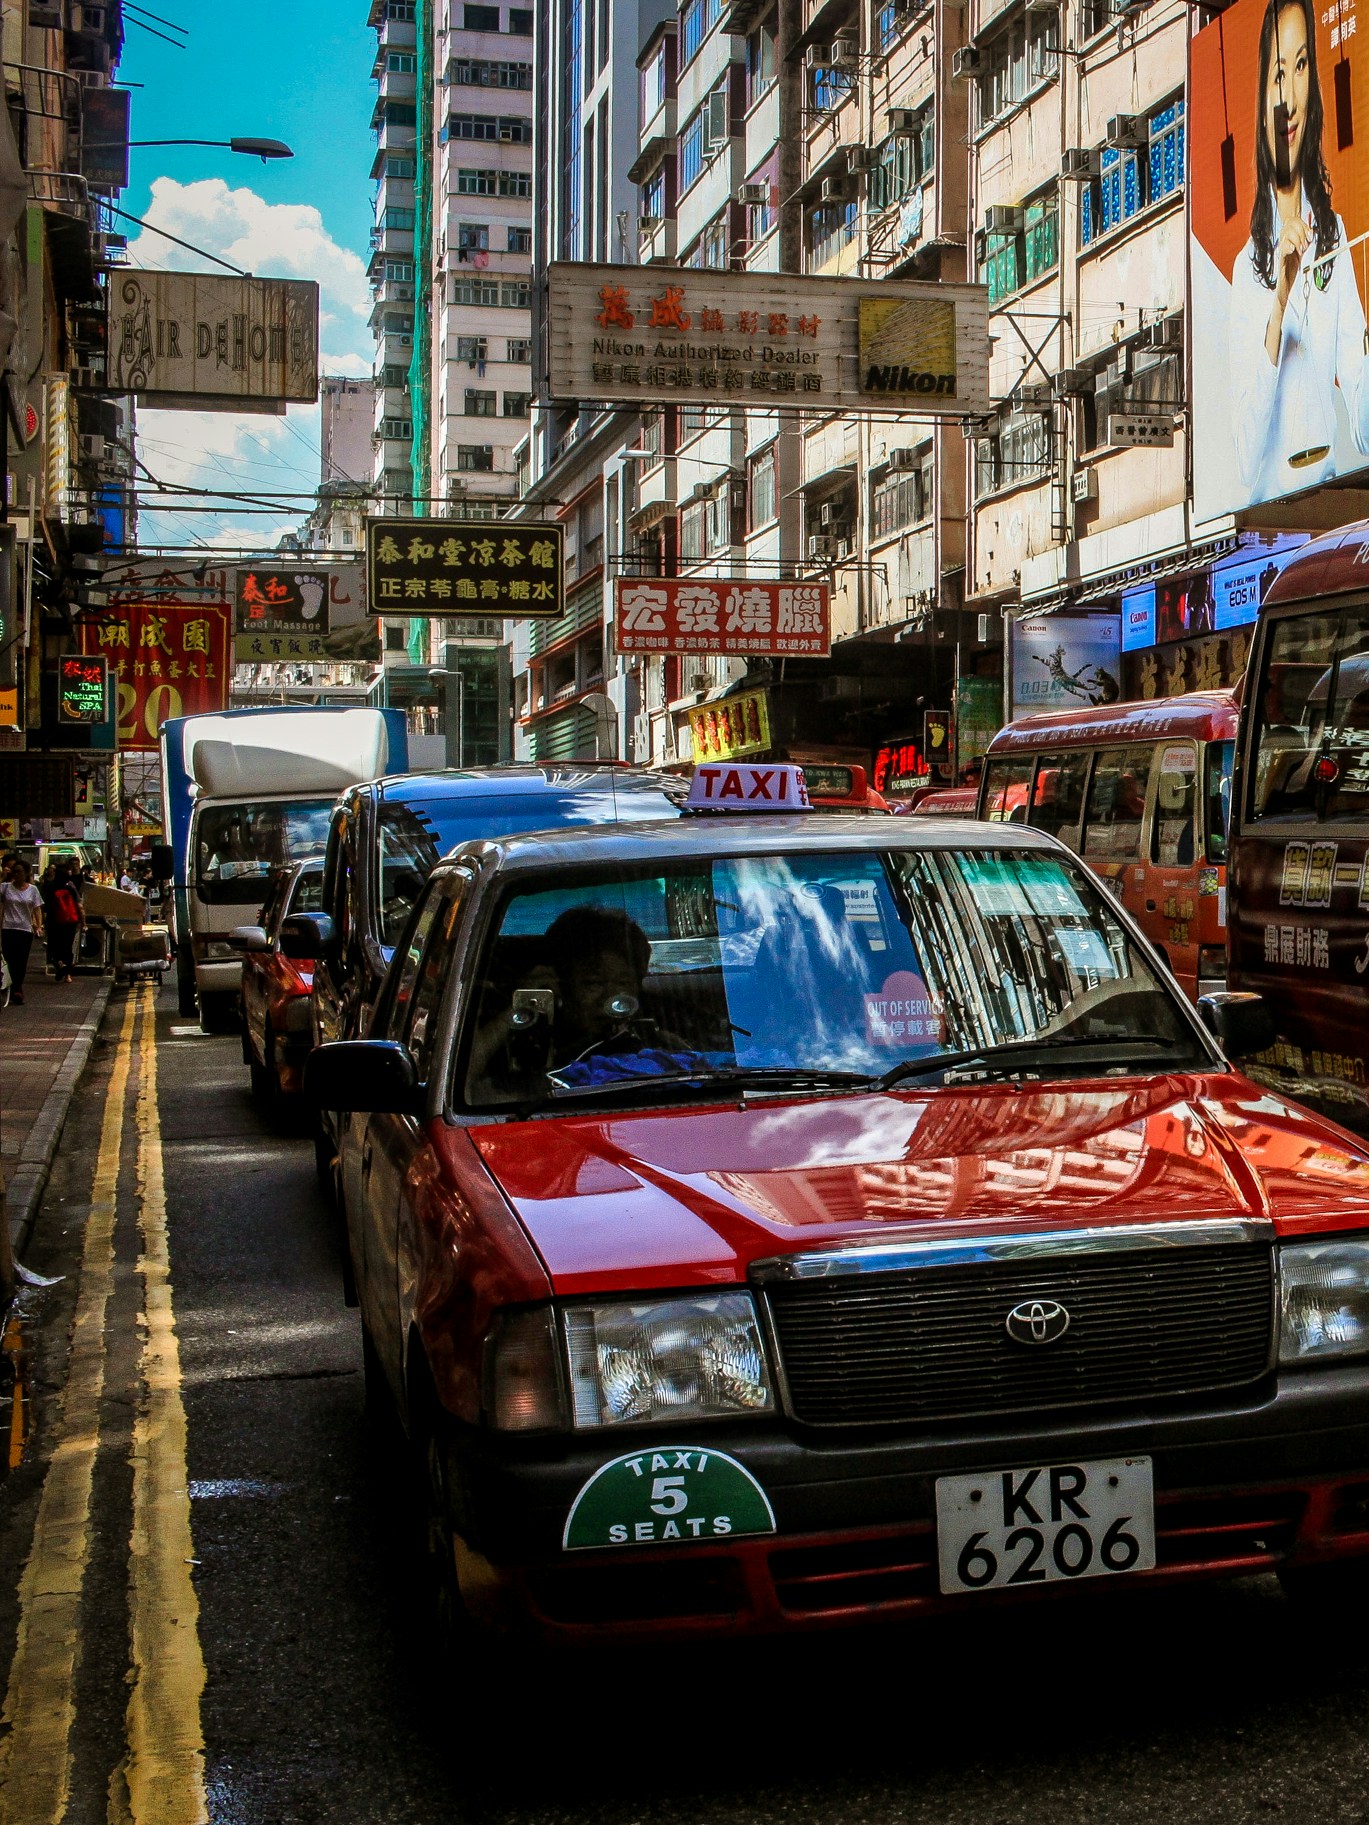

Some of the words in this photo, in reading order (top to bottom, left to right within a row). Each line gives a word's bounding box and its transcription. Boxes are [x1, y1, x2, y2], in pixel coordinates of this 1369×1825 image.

[593, 338, 645, 357] Nikon
[654, 342, 753, 362] Authorized
[763, 346, 820, 365] Dealer
[865, 364, 957, 394] Nikon
[621, 585, 823, 634] 宏發燒臘
[1229, 590, 1247, 607] EOS
[1249, 586, 1256, 603] M
[244, 619, 269, 630] Foot
[273, 620, 321, 632] Massage
[1022, 624, 1047, 632] Canon
[1130, 611, 1148, 625] Canon
[64, 691, 103, 701] Natural
[78, 682, 103, 692] Thai
[699, 768, 788, 801] TAXI
[1264, 924, 1330, 969] 鼎展財務
[867, 1001, 889, 1017] OUT
[891, 1000, 903, 1016] OF
[872, 1020, 940, 1038] 暫停載客
[625, 1451, 708, 1478] TAXI
[650, 1476, 689, 1515] 5
[1002, 1466, 1090, 1528] KR
[609, 1515, 732, 1543] SEATS
[957, 1516, 1140, 1588] 6206
